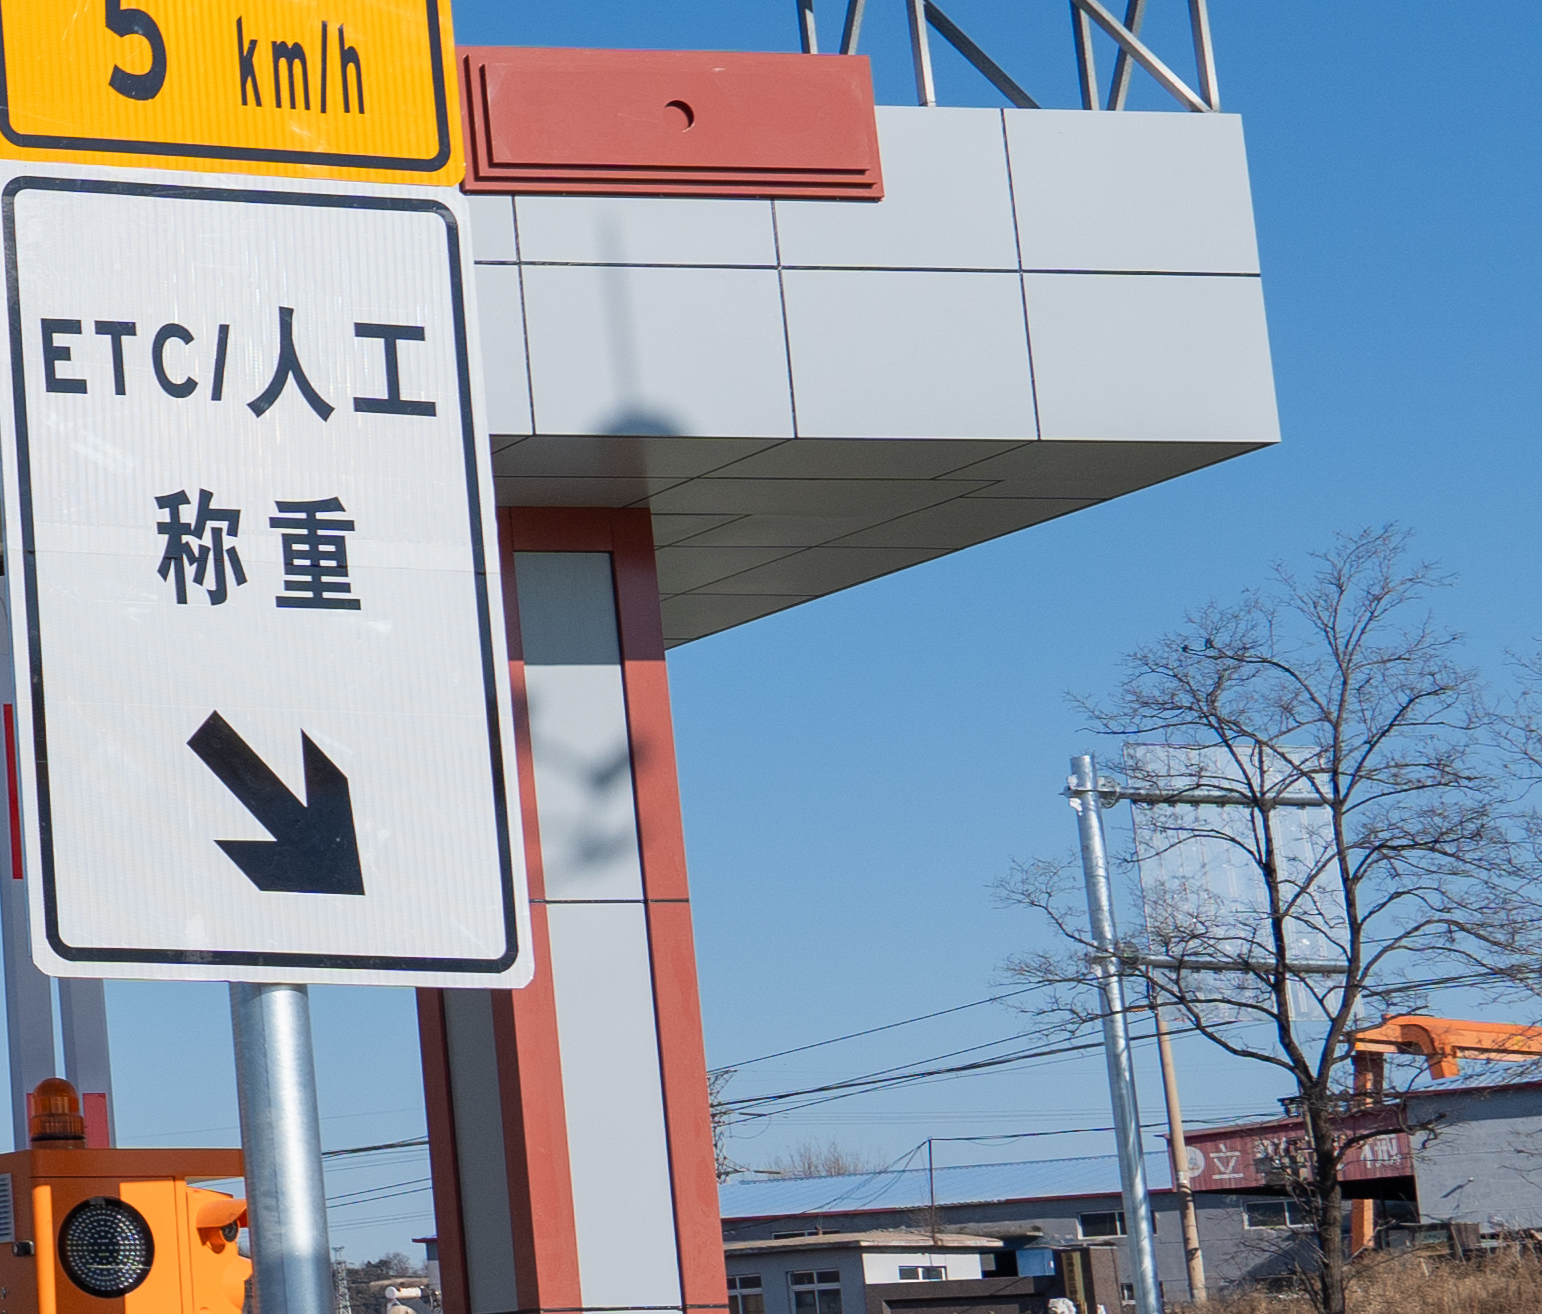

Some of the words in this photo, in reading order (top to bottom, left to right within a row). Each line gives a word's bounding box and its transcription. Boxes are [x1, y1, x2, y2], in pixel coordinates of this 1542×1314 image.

[236, 17, 365, 115] km/h
[40, 305, 437, 422] ETC/人工
[155, 488, 362, 611] 称重
